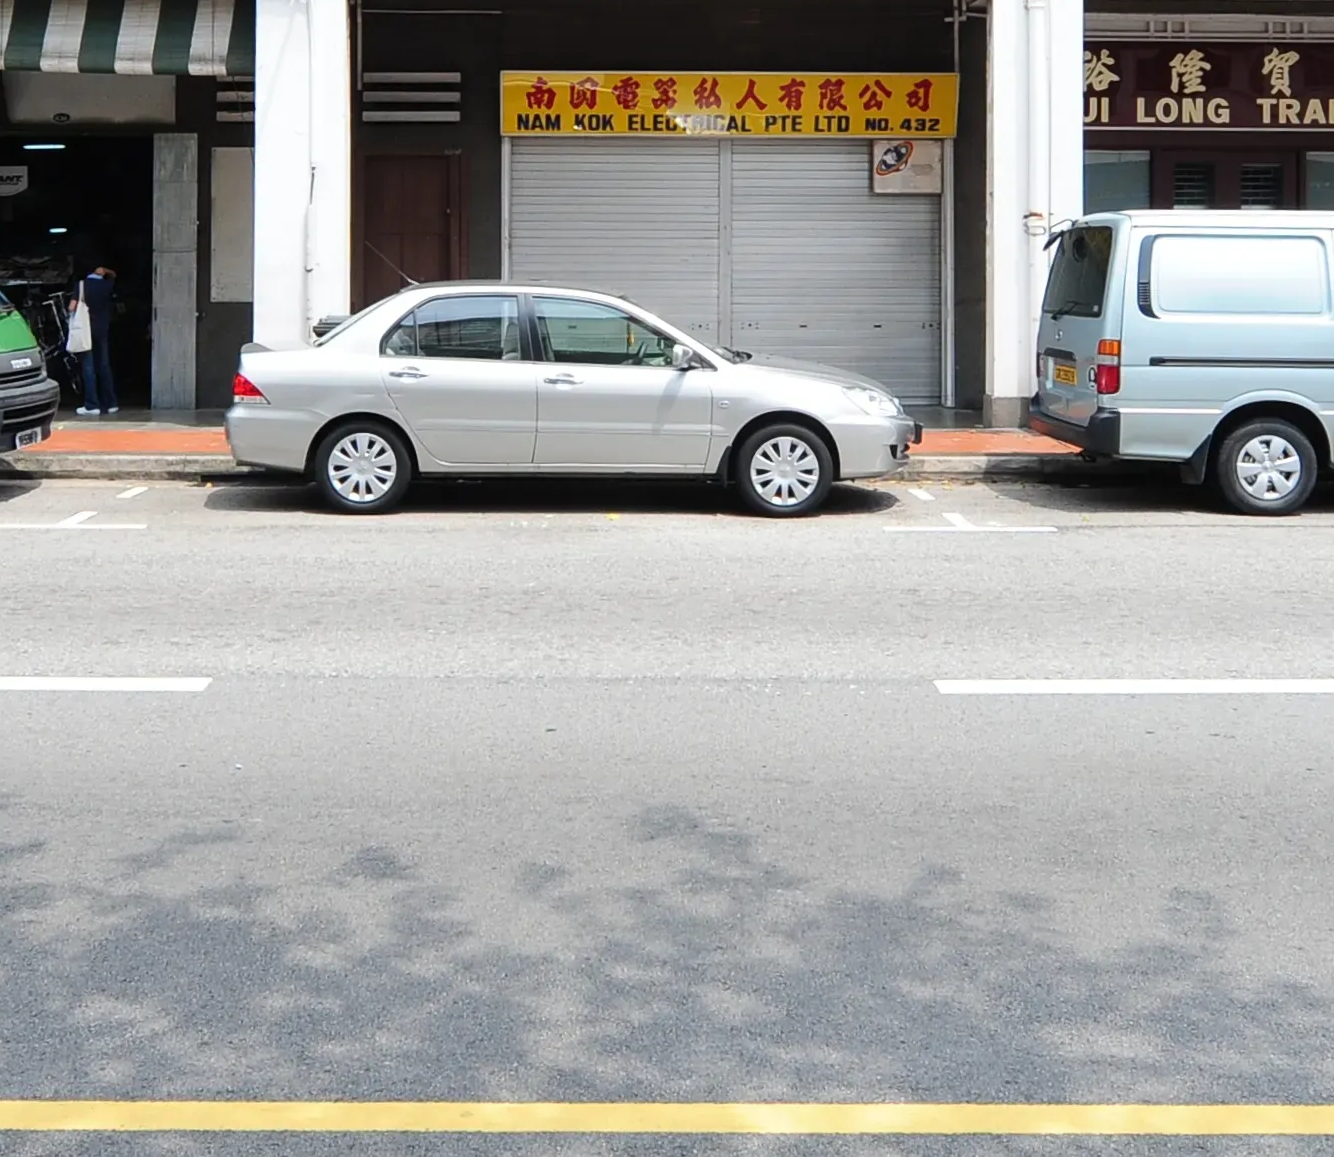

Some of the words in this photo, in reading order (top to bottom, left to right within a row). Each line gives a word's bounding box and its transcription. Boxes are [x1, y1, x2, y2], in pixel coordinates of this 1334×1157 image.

[1136, 97, 1231, 124] LONG
[516, 113, 562, 131] NAM
[574, 114, 615, 132] KOK
[628, 114, 752, 133] ELECTRICAL
[765, 115, 803, 132] PTE
[814, 115, 850, 133] LTD
[865, 118, 894, 132] NO.
[899, 118, 941, 132] 432
